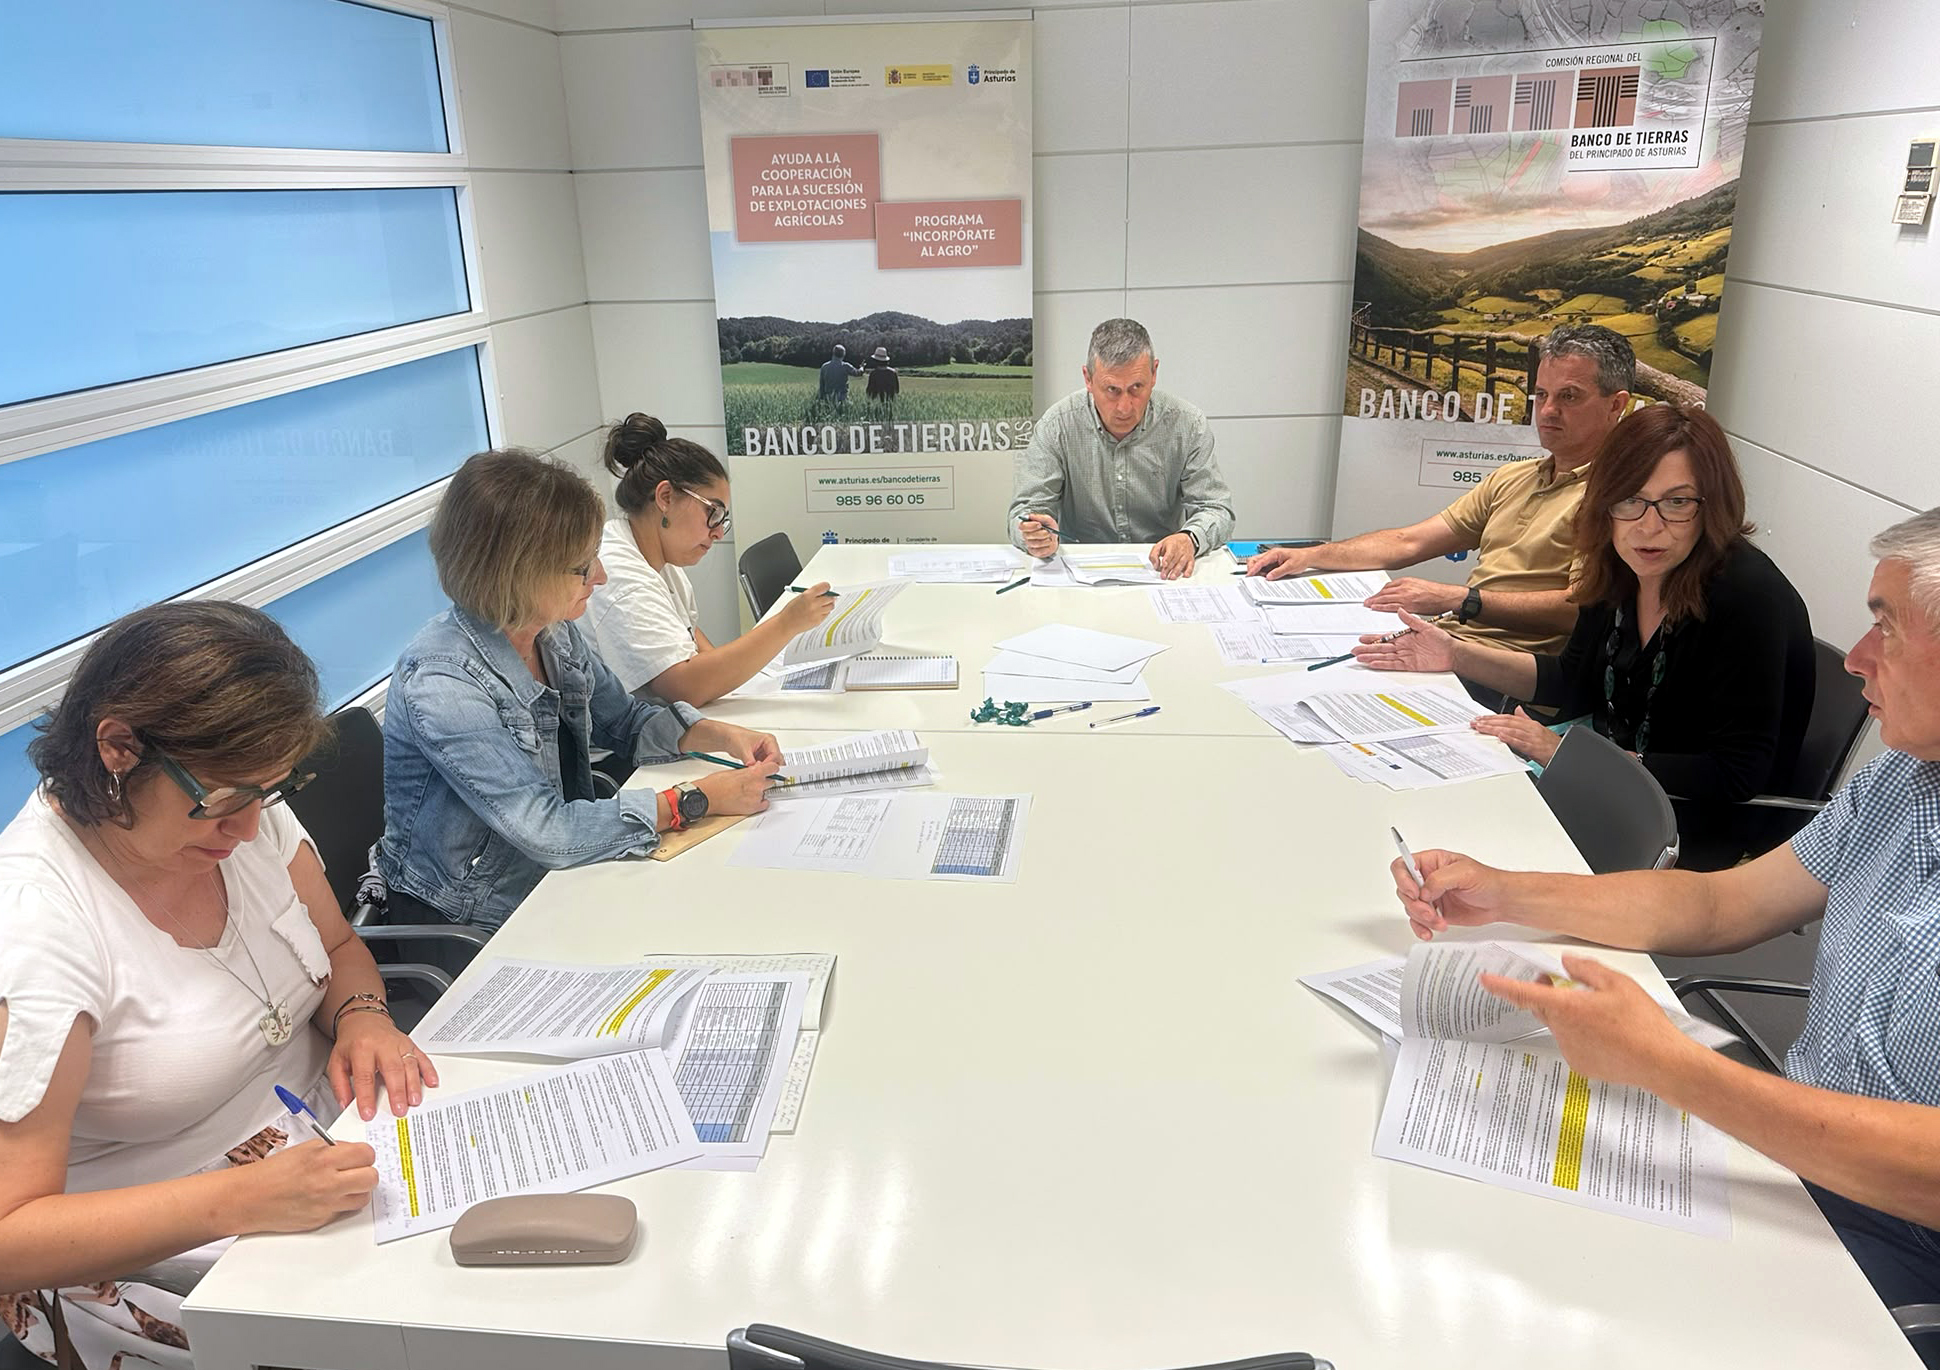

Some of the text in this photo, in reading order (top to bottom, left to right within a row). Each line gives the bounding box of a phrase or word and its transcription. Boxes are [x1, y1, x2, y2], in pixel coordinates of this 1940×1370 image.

[1545, 52, 1642, 68] COMISIÓN REGIONAL DEL
[1571, 130, 1689, 148] BANCO DE TIERRAS
[771, 152, 841, 165] AYUDA A LA
[1569, 146, 1687, 160] DEL PRINCIPADO DE ASTURIAS
[761, 165, 852, 181] COOPERACIÓN
[751, 180, 863, 197] PARA LA SUCESIÓN
[750, 198, 867, 212] DE EXPLOTACIONES
[774, 212, 844, 227] AGRÍCOLAS
[915, 214, 984, 227] PROGRAMA
[921, 246, 935, 257] AL
[1359, 388, 1461, 424] BANCO
[1474, 392, 1515, 425] DE
[745, 421, 1011, 456] BANCO DE TIERRAS
[818, 475, 941, 485] www.asturias.es/bancodetierras
[1453, 471, 1482, 483] 985
[836, 494, 925, 506] 985 96 60 05
[845, 537, 881, 545] Principado
